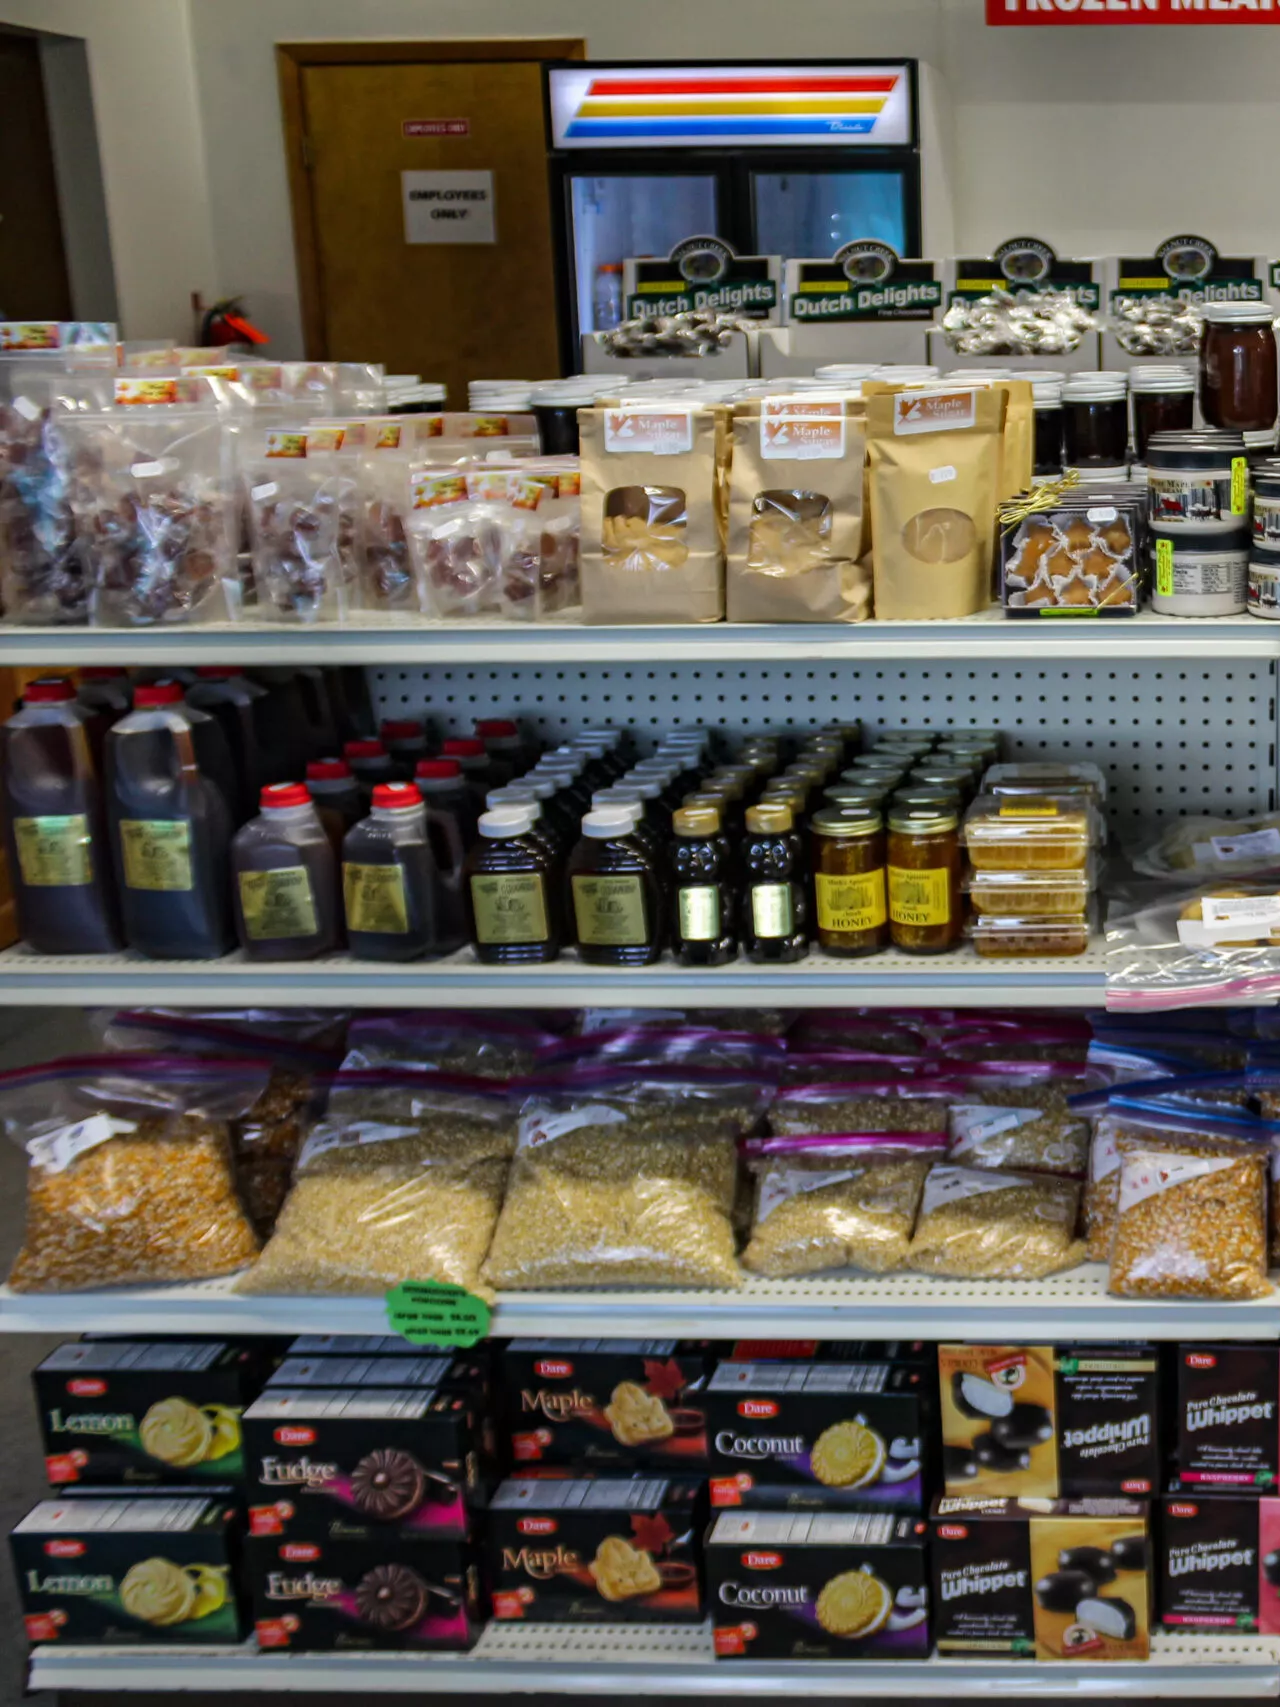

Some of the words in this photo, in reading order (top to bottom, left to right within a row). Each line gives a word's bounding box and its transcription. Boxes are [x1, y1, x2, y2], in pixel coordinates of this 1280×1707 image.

[409, 190, 487, 201] EMPLOYEES
[430, 208, 468, 219] ONLY
[632, 295, 688, 319] Dutch
[694, 283, 773, 308] Delights
[793, 292, 852, 316] Dutch
[858, 284, 938, 308] Delights
[1178, 282, 1259, 302] Delights
[925, 399, 962, 414] Maple
[638, 419, 678, 432] Maple
[793, 426, 830, 439] Maple
[832, 916, 872, 929] HONEY
[892, 909, 930, 922] HONEY
[540, 1362, 568, 1375] Dare
[1189, 1355, 1212, 1366] Dare
[71, 1381, 103, 1394] Dare
[520, 1389, 594, 1413] Maple
[743, 1402, 773, 1415] Dare
[1186, 1401, 1208, 1412] Pure
[1209, 1391, 1256, 1407] Chocolate
[49, 1408, 135, 1434] Lemon
[1186, 1402, 1272, 1432] Whippet
[279, 1428, 313, 1443] Dare
[1063, 1413, 1150, 1447] Whippet
[714, 1431, 803, 1456] Coconut
[260, 1456, 336, 1485] Fudge
[1171, 1505, 1193, 1515] Dare
[522, 1519, 551, 1532] Dare
[941, 1528, 963, 1536] Dare
[284, 1546, 316, 1559] Dare
[1169, 1546, 1191, 1558] Pure
[1192, 1539, 1236, 1554] Chocolate
[503, 1546, 579, 1571] Maple
[746, 1553, 778, 1566] Dare
[1169, 1548, 1253, 1577] Whippet
[940, 1569, 962, 1580] Pure
[963, 1560, 1008, 1575] Chocolate
[27, 1569, 114, 1593] Lemon
[265, 1572, 343, 1600] Fudge
[941, 1571, 1026, 1600] Whippet
[718, 1582, 808, 1606] Coconut
